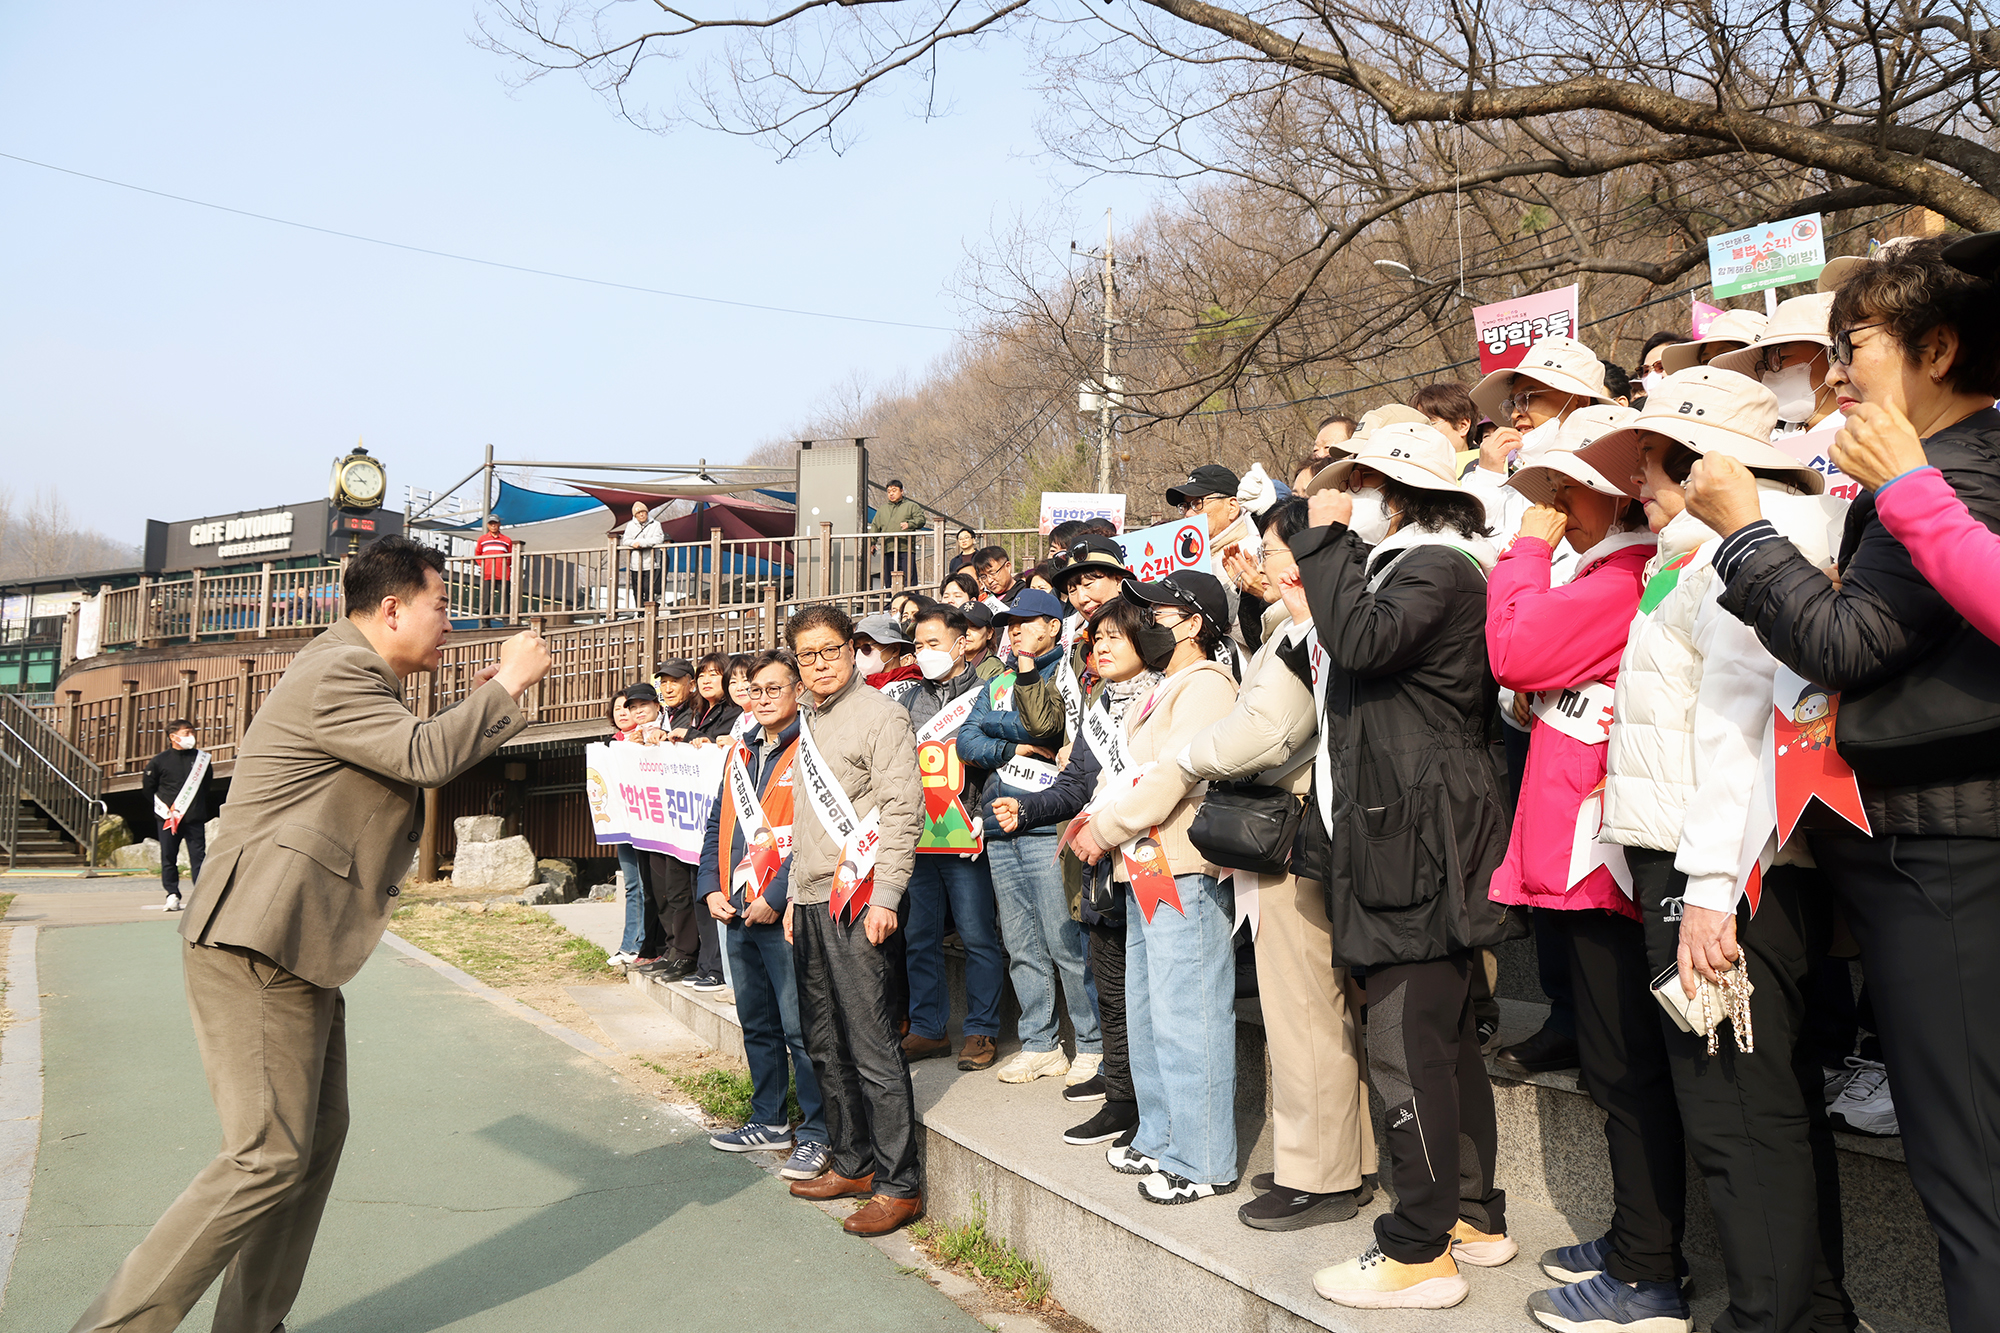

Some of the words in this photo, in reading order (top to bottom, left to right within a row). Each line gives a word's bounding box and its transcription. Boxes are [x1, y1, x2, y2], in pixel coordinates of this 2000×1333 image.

[1716, 233, 1752, 252] 그만해요
[1732, 244, 1757, 260] 불법
[1762, 236, 1792, 254] 소각!
[1718, 264, 1753, 276] 함께해요
[1757, 256, 1783, 273] 산불
[1787, 248, 1819, 266] 예방!
[1482, 310, 1571, 355] 방학3동
[189, 520, 225, 547] CAFE
[225, 511, 294, 541] DOYOUNG
[933, 705, 966, 732] 한순간
[801, 737, 855, 837] 주민자치협의회
